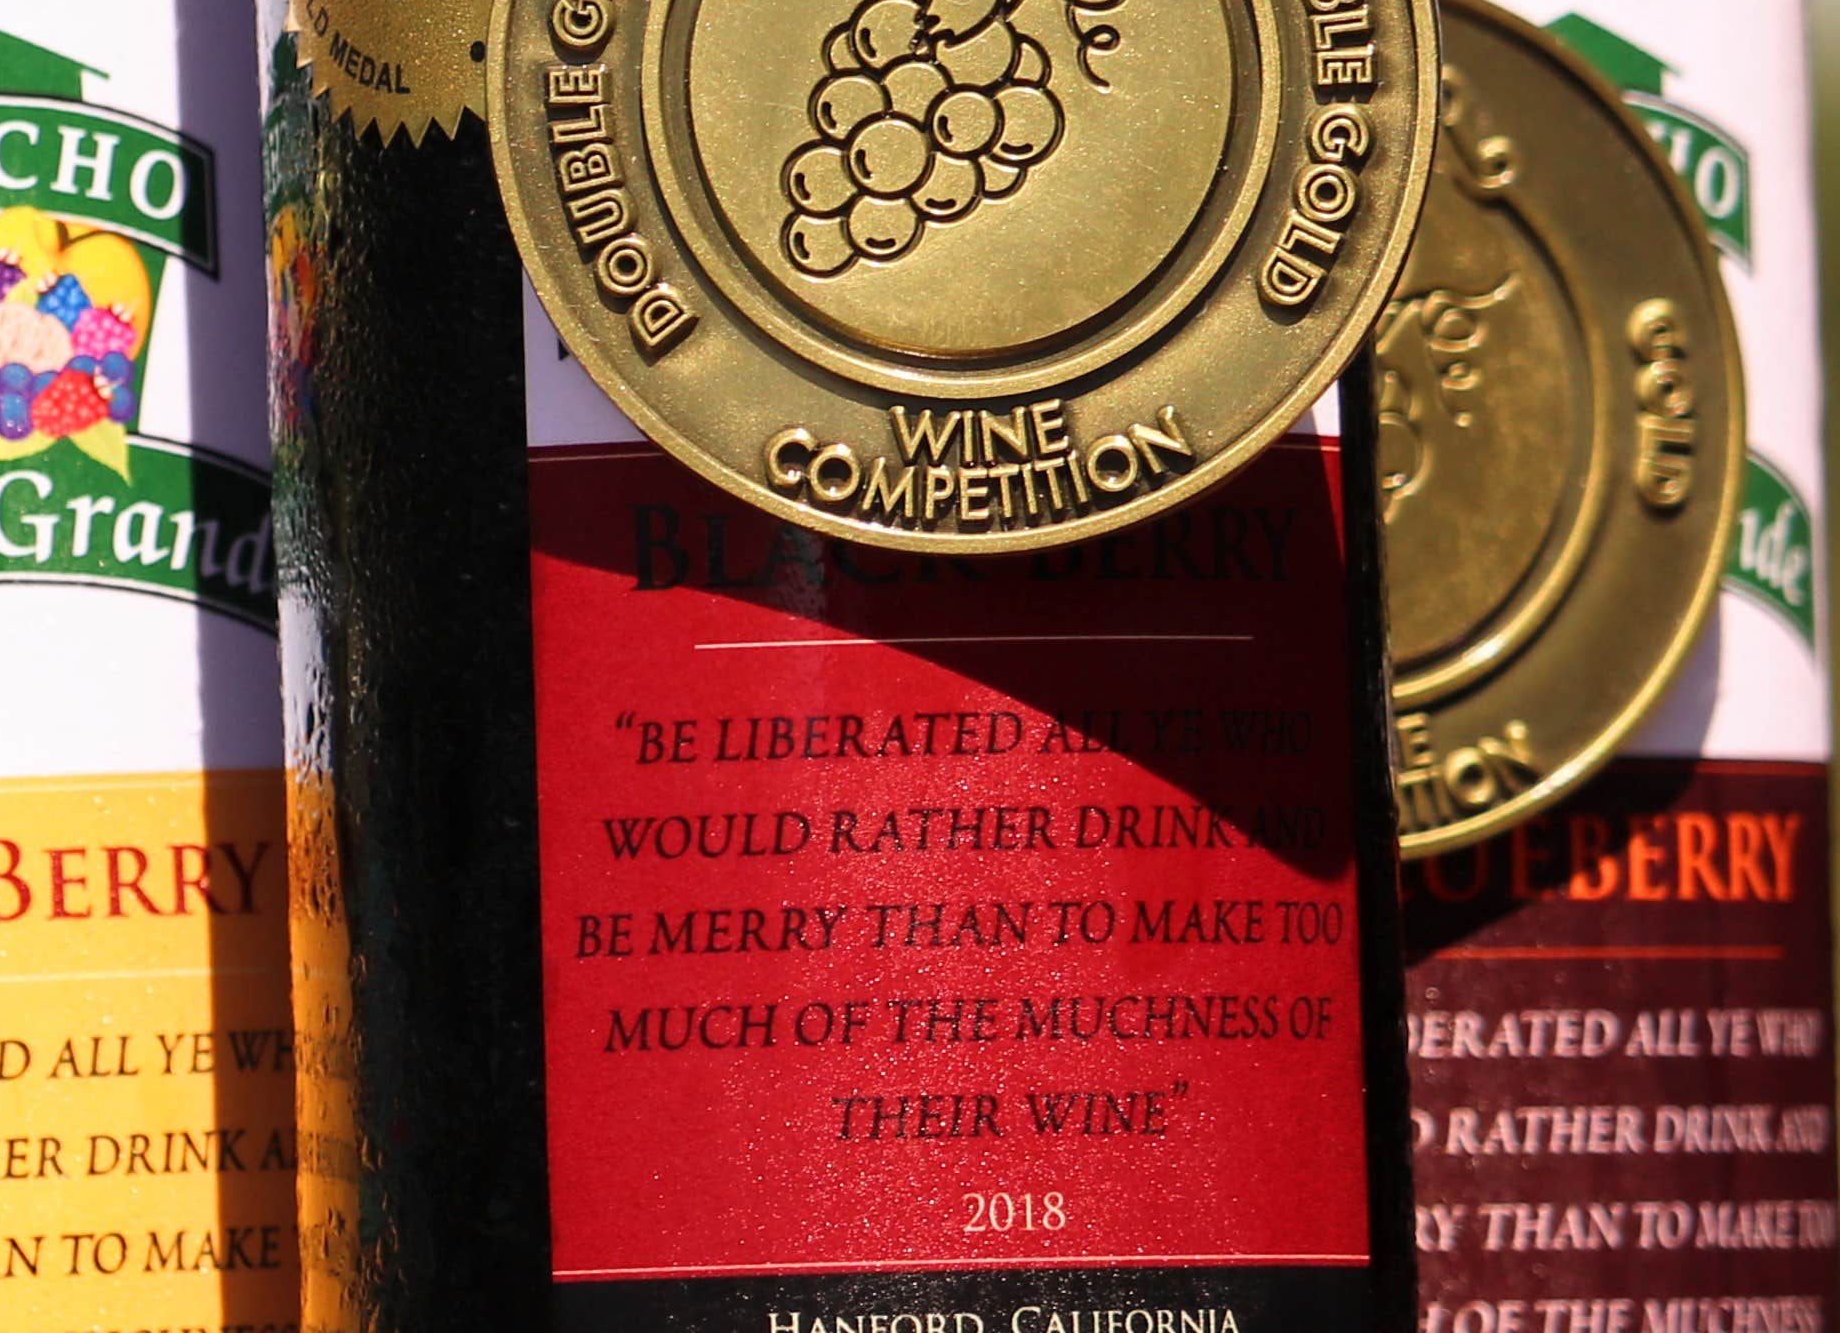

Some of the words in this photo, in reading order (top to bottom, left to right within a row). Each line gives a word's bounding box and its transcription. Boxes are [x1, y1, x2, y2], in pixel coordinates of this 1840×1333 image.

[328, 28, 412, 96] MEDAL
[544, 62, 700, 354] DOUBLE
[1255, 108, 1368, 318] GOLD
[889, 401, 1070, 462] WINE
[765, 405, 1196, 525] COMPETITION
[715, 709, 1025, 763] LIBERATED
[1039, 708, 1136, 757] ALL
[602, 807, 813, 863] WOULD
[829, 803, 1059, 855] RATHER
[1076, 803, 1233, 851] DRINK
[575, 914, 634, 961] BE
[647, 903, 845, 956] MERRY
[864, 901, 1048, 953] THAN
[1058, 901, 1118, 947] TO
[1127, 899, 1267, 947] MAKE
[1274, 899, 1344, 945] TOO
[602, 1004, 777, 1054] MUCH
[793, 1001, 875, 1048] OF
[885, 998, 999, 1046] THE
[1014, 993, 1280, 1045] MUCHNESS
[1287, 993, 1332, 1040] OF
[1624, 1008, 1702, 1058] ALL
[47, 1037, 140, 1079] ALL
[155, 1033, 218, 1074] YE
[830, 1091, 1007, 1144] THEIR
[1446, 1104, 1646, 1156] RATHER
[1653, 1104, 1773, 1155] DRINK
[88, 1132, 246, 1177] DRINK
[961, 1192, 1068, 1234] 2018
[1477, 1201, 1625, 1251] THAN
[1633, 1200, 1695, 1249] TO
[60, 1232, 126, 1276] TO
[142, 1226, 281, 1273] MAKE
